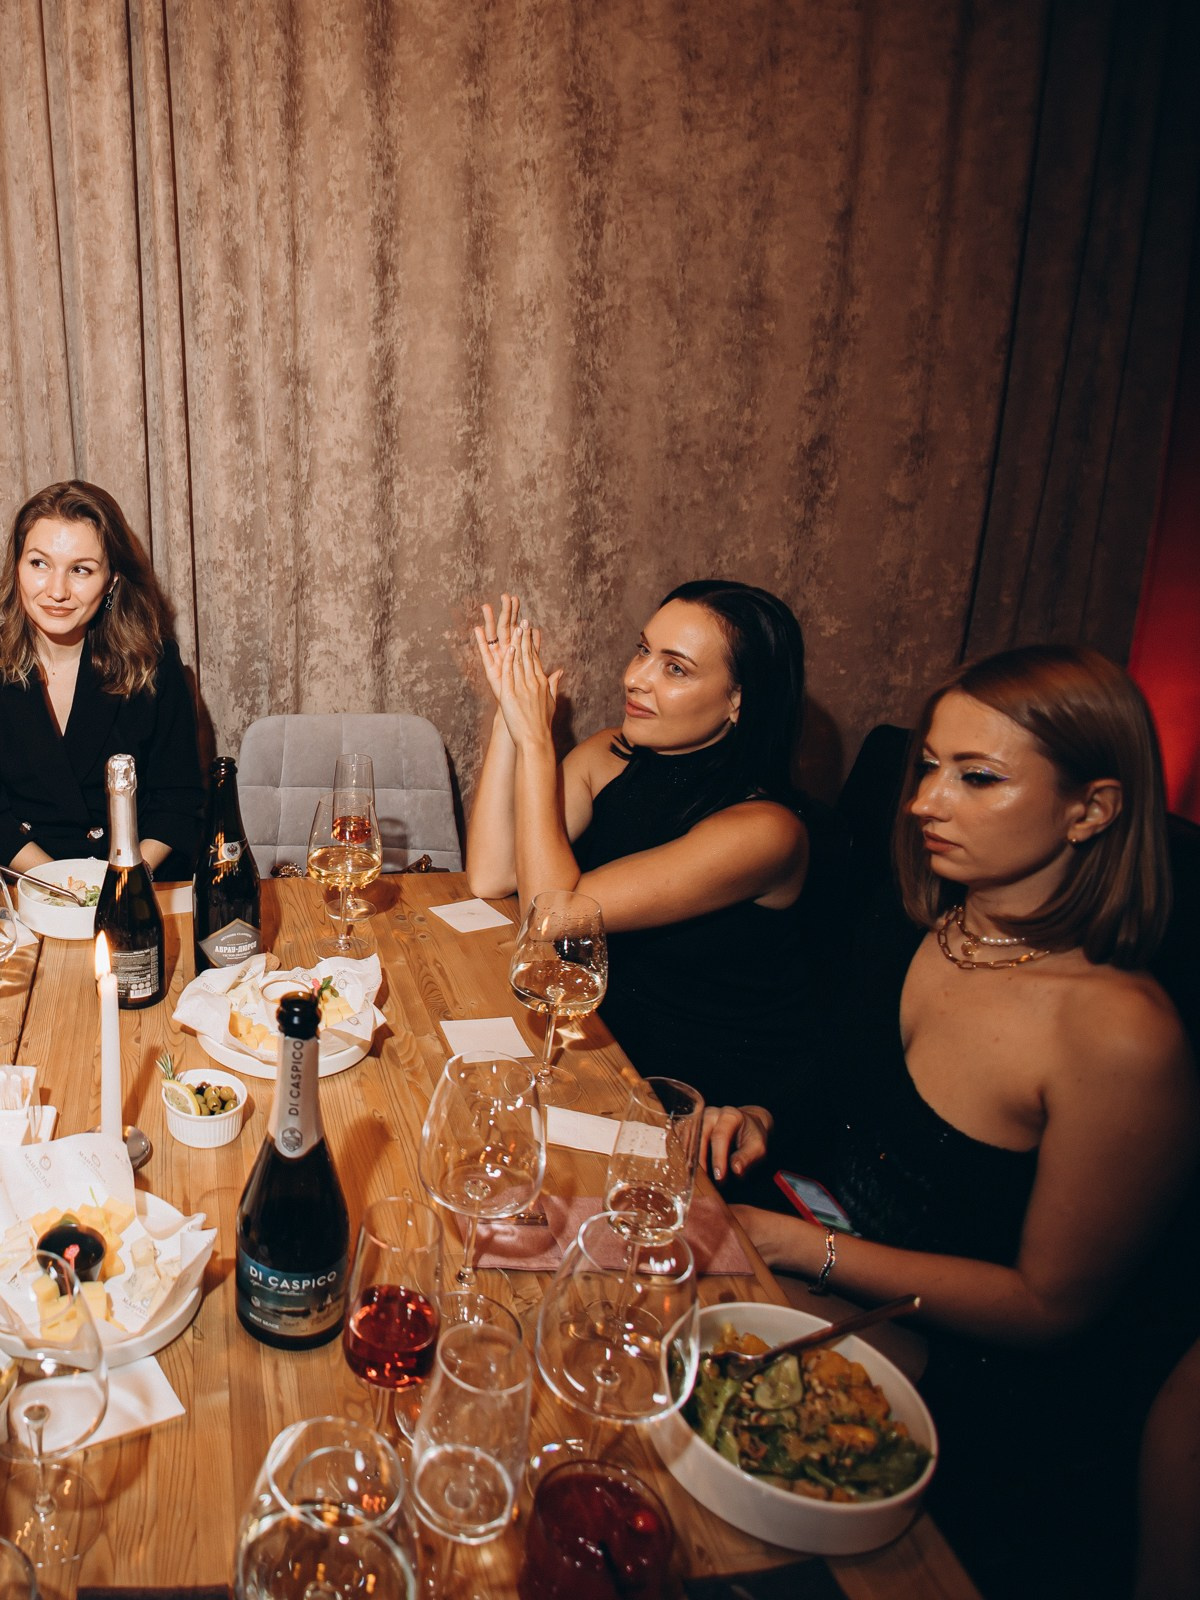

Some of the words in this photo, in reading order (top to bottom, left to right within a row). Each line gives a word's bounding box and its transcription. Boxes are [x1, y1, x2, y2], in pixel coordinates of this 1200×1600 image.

[289, 1040, 304, 1099] CASPICO
[288, 1102, 299, 1116] DI
[249, 1265, 263, 1281] DI
[268, 1271, 337, 1290] CASPICO
